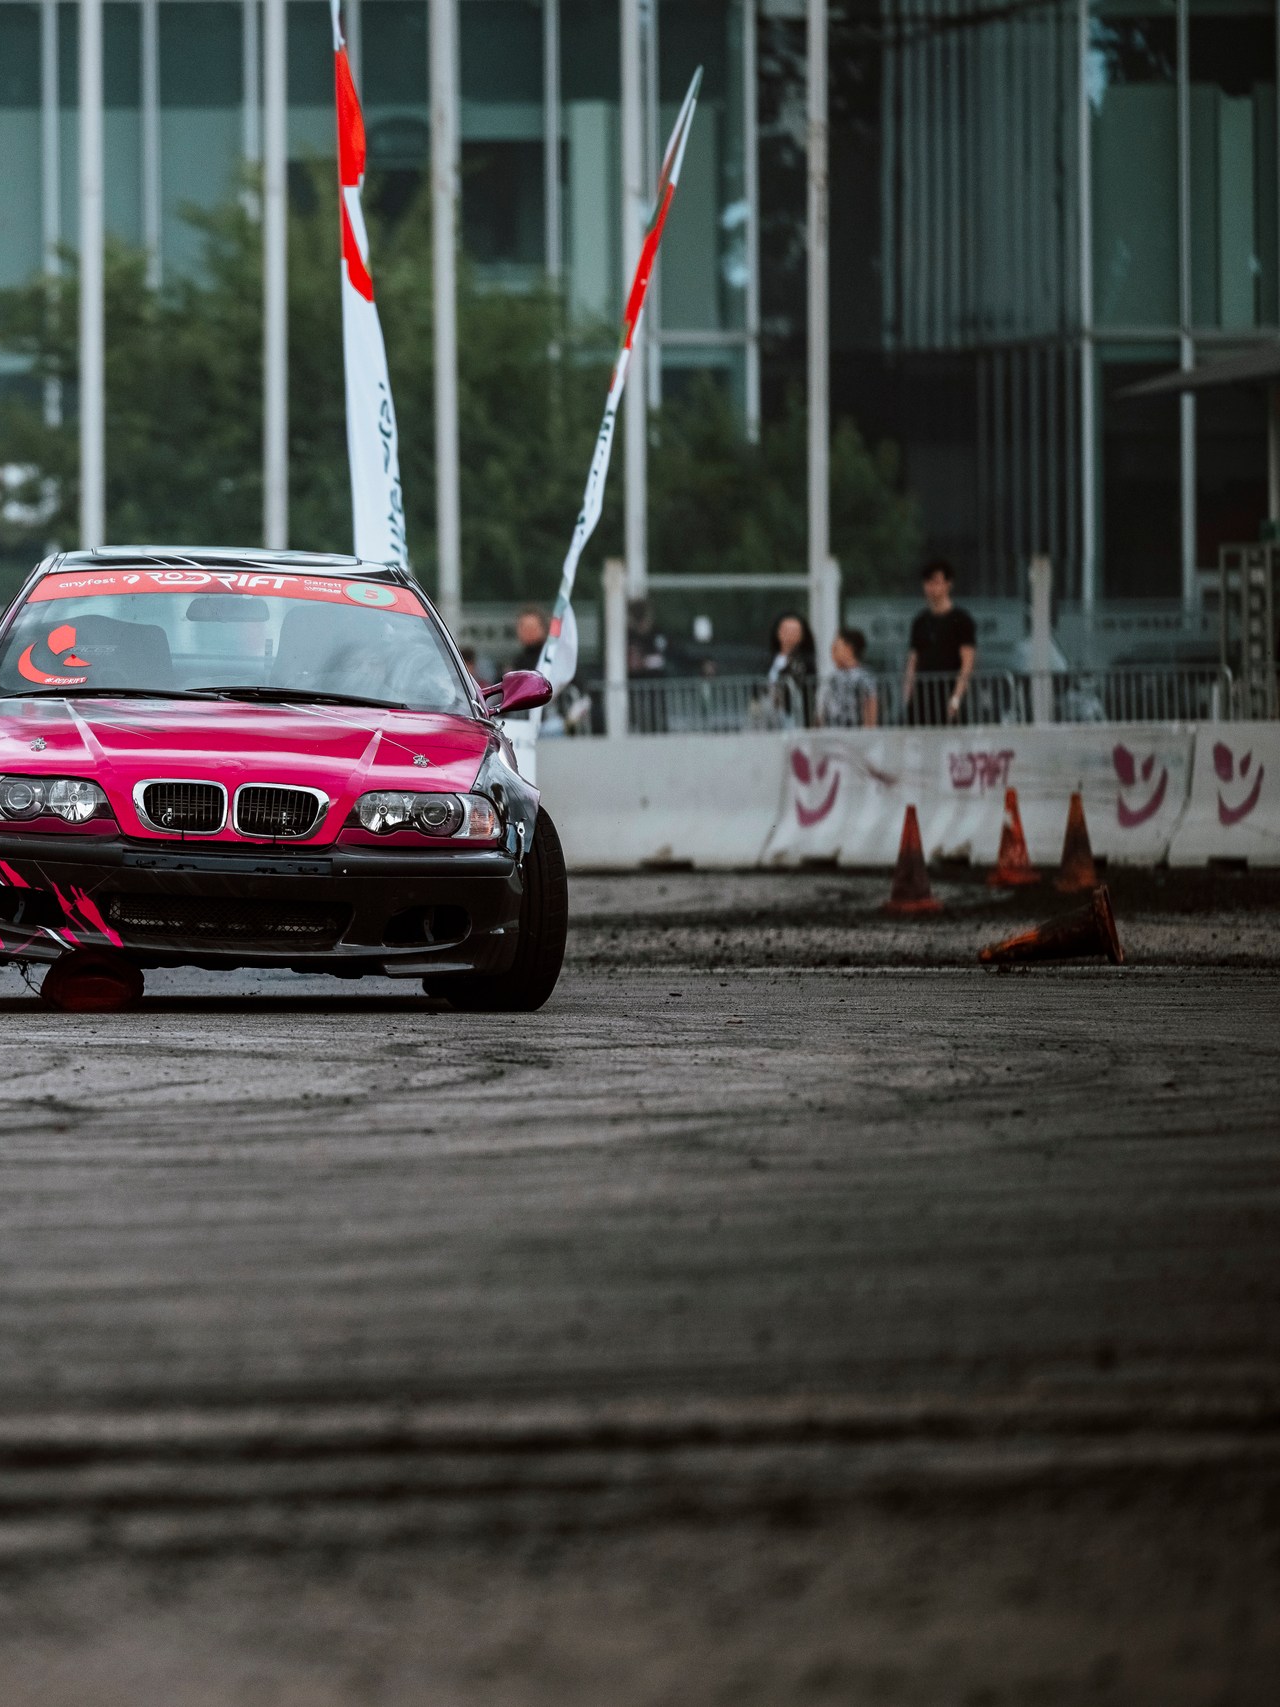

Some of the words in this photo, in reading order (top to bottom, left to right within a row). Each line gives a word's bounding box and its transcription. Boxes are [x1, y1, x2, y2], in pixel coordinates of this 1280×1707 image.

[58, 577, 116, 588] anyfest
[304, 579, 342, 589] Garrett
[363, 588, 379, 600] 5
